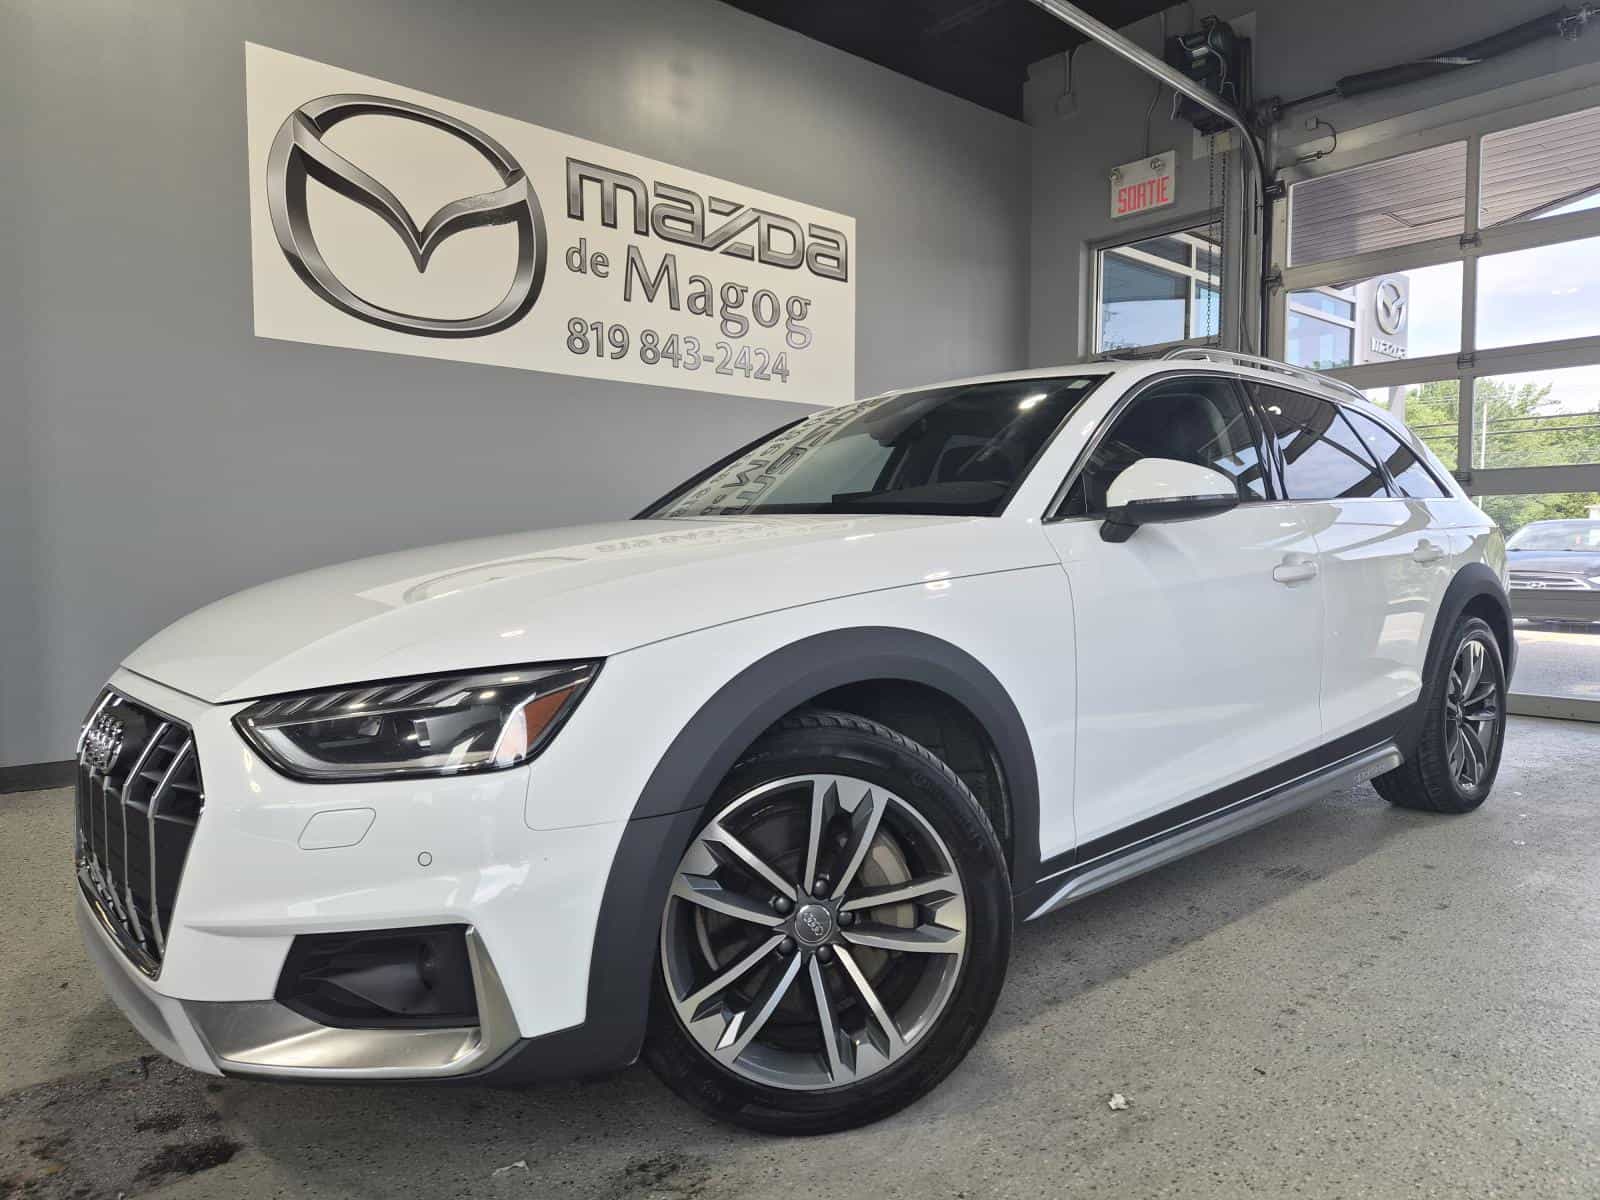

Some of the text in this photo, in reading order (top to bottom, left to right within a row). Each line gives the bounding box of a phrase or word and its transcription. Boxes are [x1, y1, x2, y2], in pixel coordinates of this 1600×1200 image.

[1118, 176, 1169, 213] SORTIE
[565, 238, 812, 349] de Magog
[566, 317, 790, 383] 819 843-2424
